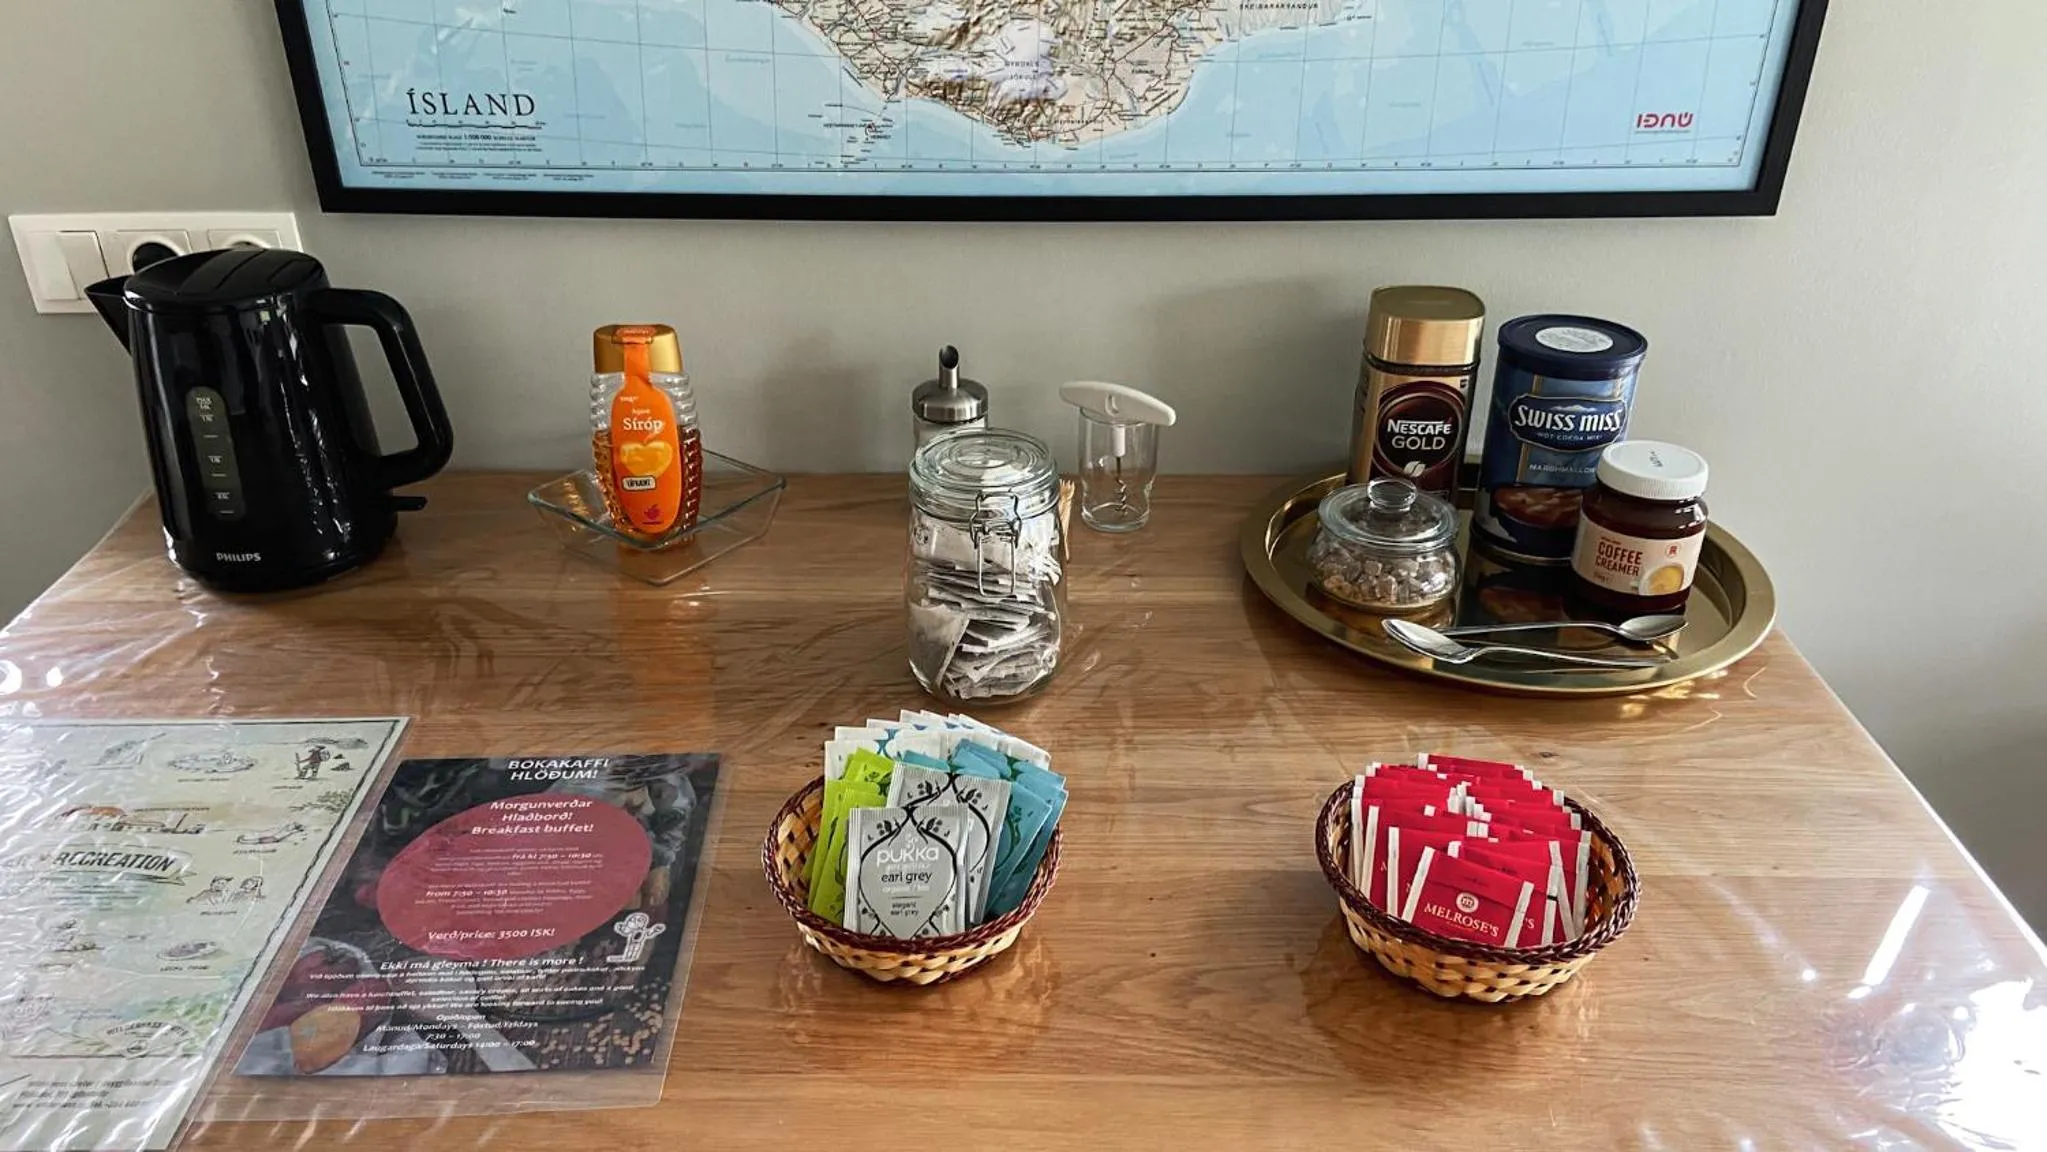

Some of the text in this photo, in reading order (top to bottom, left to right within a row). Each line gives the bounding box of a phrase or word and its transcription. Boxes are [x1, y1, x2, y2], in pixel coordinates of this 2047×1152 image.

[406, 88, 535, 116] ÍSLAND
[623, 416, 664, 433] Síróp
[1515, 404, 1576, 431] SWISS
[1391, 435, 1446, 450] GOLD
[216, 551, 261, 562] PHILIPS
[1598, 541, 1643, 565] COFFEE
[1595, 555, 1640, 576] CREAMER
[511, 769, 598, 780] HLÖÐUM!
[490, 800, 593, 811] Morgunverðar
[502, 812, 573, 822] Hlaðborð!
[471, 824, 594, 835] Breakfast buffet!
[53, 851, 176, 872] RECREATION
[876, 845, 940, 868] pukka
[881, 871, 932, 884] earl grey
[1424, 903, 1499, 937] MELROSE'S
[498, 929, 528, 939] 3500
[530, 927, 556, 937] ISK!
[380, 961, 406, 970] Ekki
[410, 960, 429, 969] má
[431, 959, 480, 971] gleyma
[490, 957, 526, 966] There
[528, 957, 541, 966] is
[542, 958, 576, 966] more
